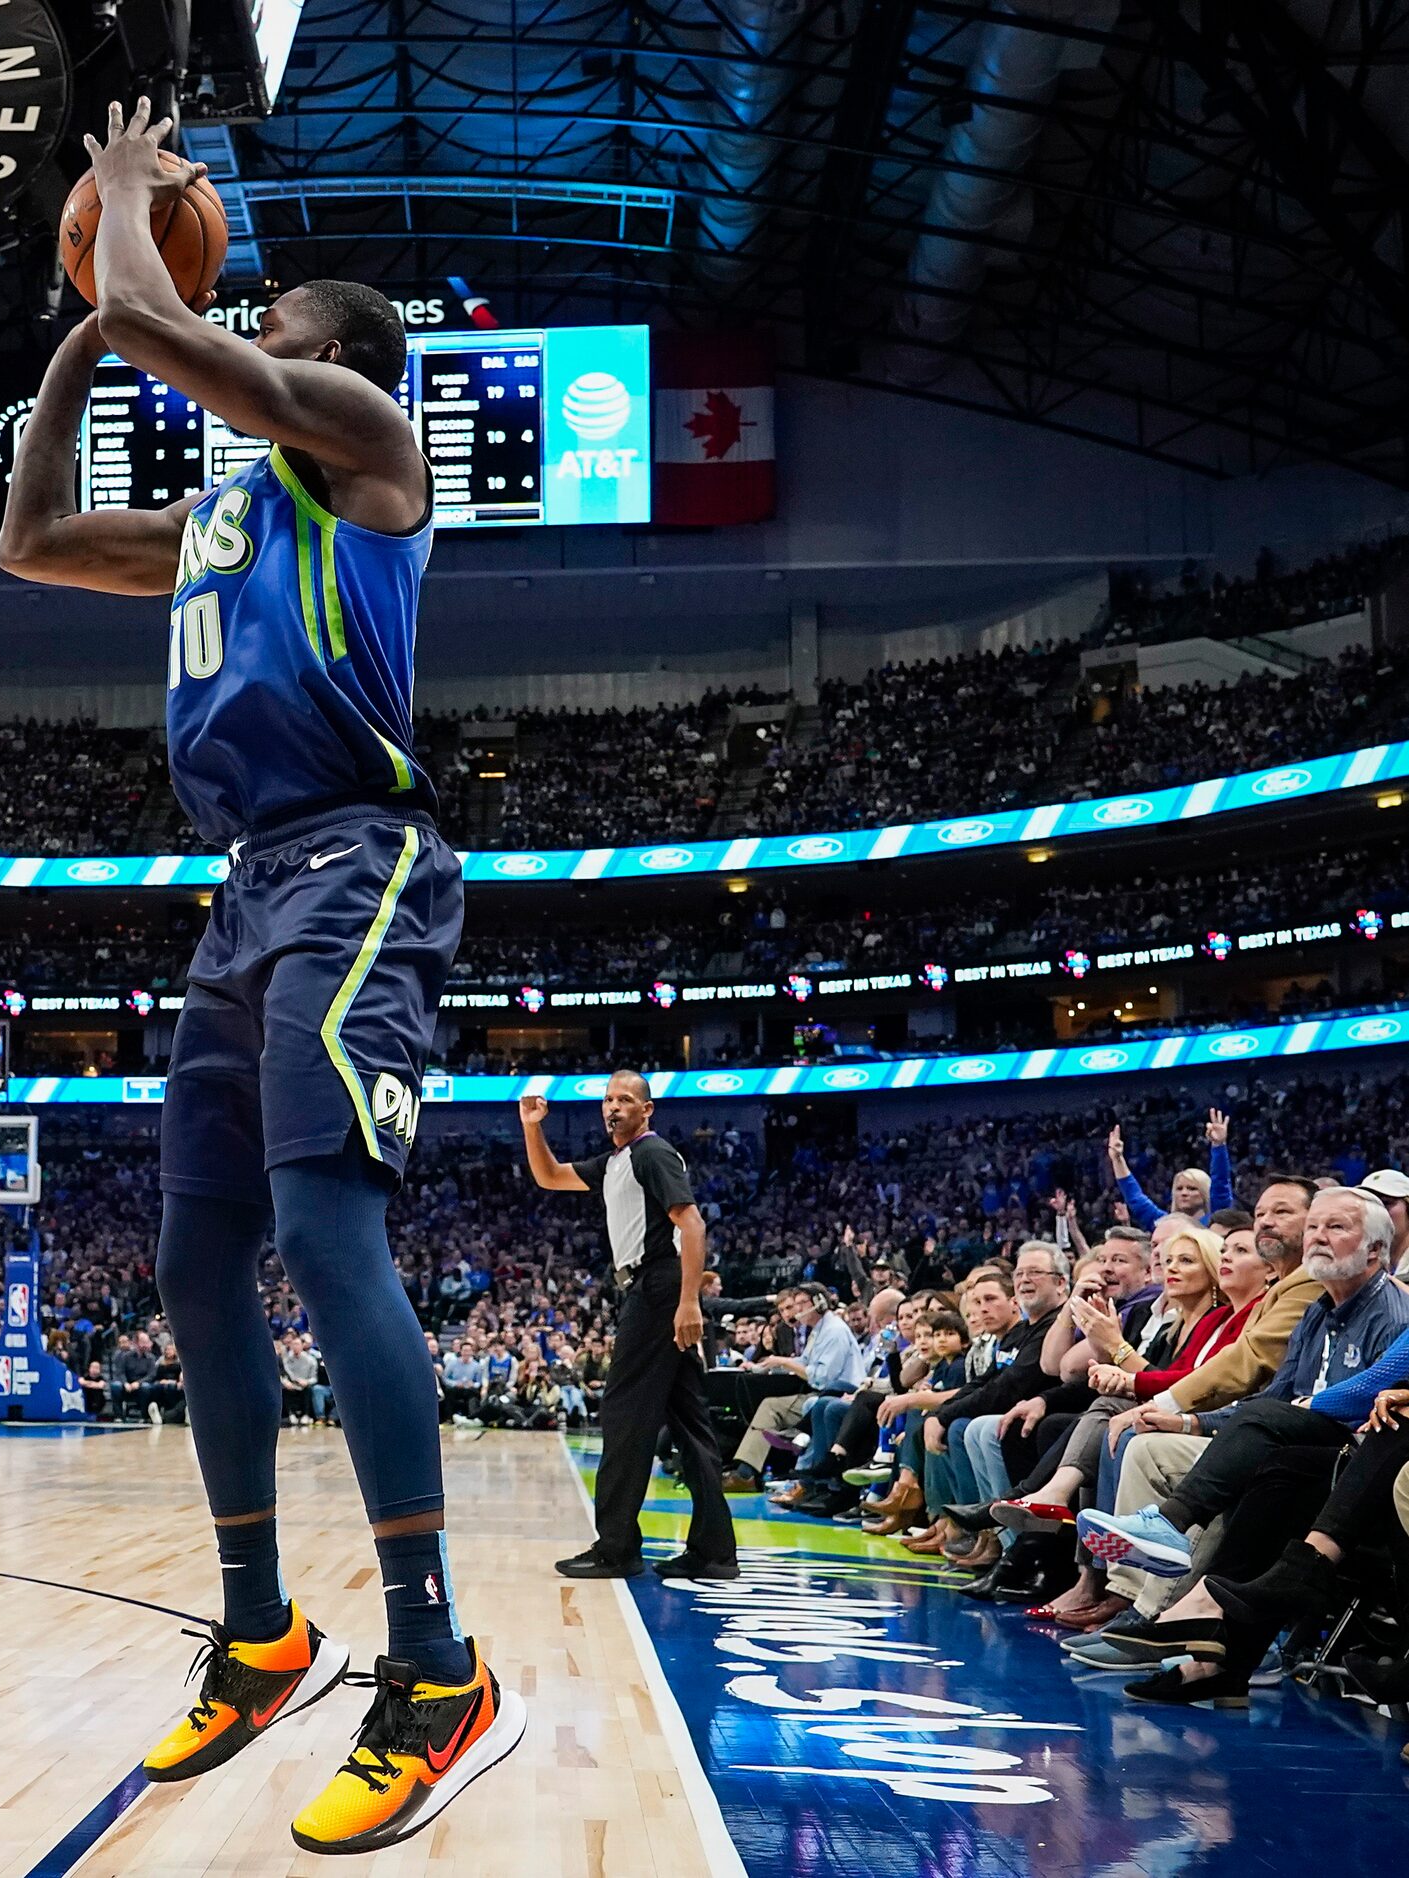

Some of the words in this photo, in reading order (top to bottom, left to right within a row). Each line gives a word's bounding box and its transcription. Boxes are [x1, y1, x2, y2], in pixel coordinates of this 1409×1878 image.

[556, 448, 638, 479] AT&T
[175, 487, 254, 598] AVS
[169, 591, 224, 691] 10
[1239, 932, 1275, 949] BEST
[1277, 930, 1291, 944] IN
[1293, 923, 1341, 941] TEXAS
[1098, 953, 1132, 968] BEST
[1135, 951, 1149, 964] IN
[1151, 945, 1193, 962] TEXAS
[955, 967, 988, 981] BEST
[991, 966, 1005, 978] IN
[1007, 962, 1051, 976] TEXAS
[683, 987, 716, 1000] BEST
[717, 987, 732, 998] IN
[733, 985, 775, 997] TEXAS
[819, 980, 852, 993] BEST
[854, 979, 868, 991] IN
[870, 975, 910, 989] TEXAS
[32, 998, 63, 1010] BEST
[65, 998, 79, 1009] IN
[80, 998, 119, 1009] TEXAS
[452, 996, 466, 1006] IN
[468, 995, 508, 1006] TEXAS
[551, 994, 583, 1005] BEST
[585, 993, 599, 1004] IN
[600, 991, 640, 1004] TEXAS
